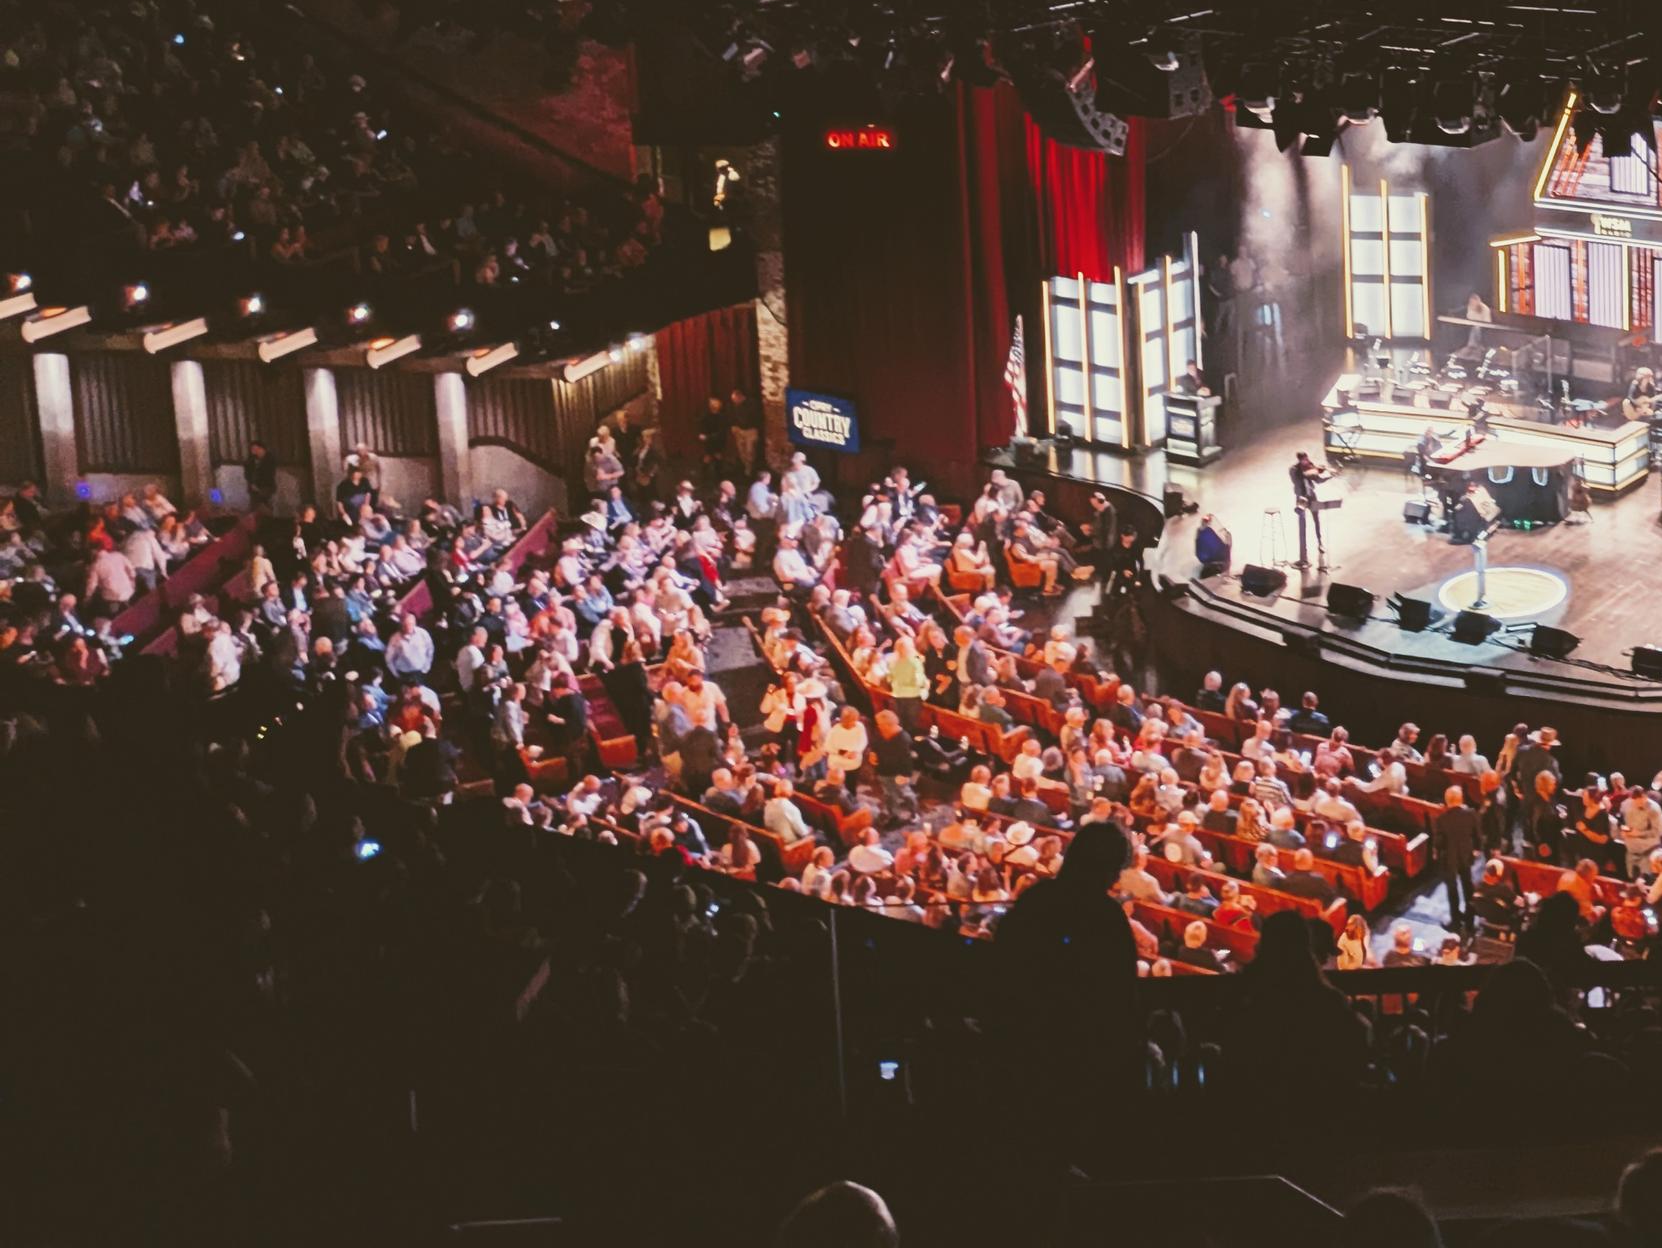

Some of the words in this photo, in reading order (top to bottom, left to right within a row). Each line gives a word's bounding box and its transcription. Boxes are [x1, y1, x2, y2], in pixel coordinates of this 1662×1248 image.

[827, 132, 855, 148] ON
[858, 132, 890, 148] AIR
[793, 406, 851, 439] COUNTRY
